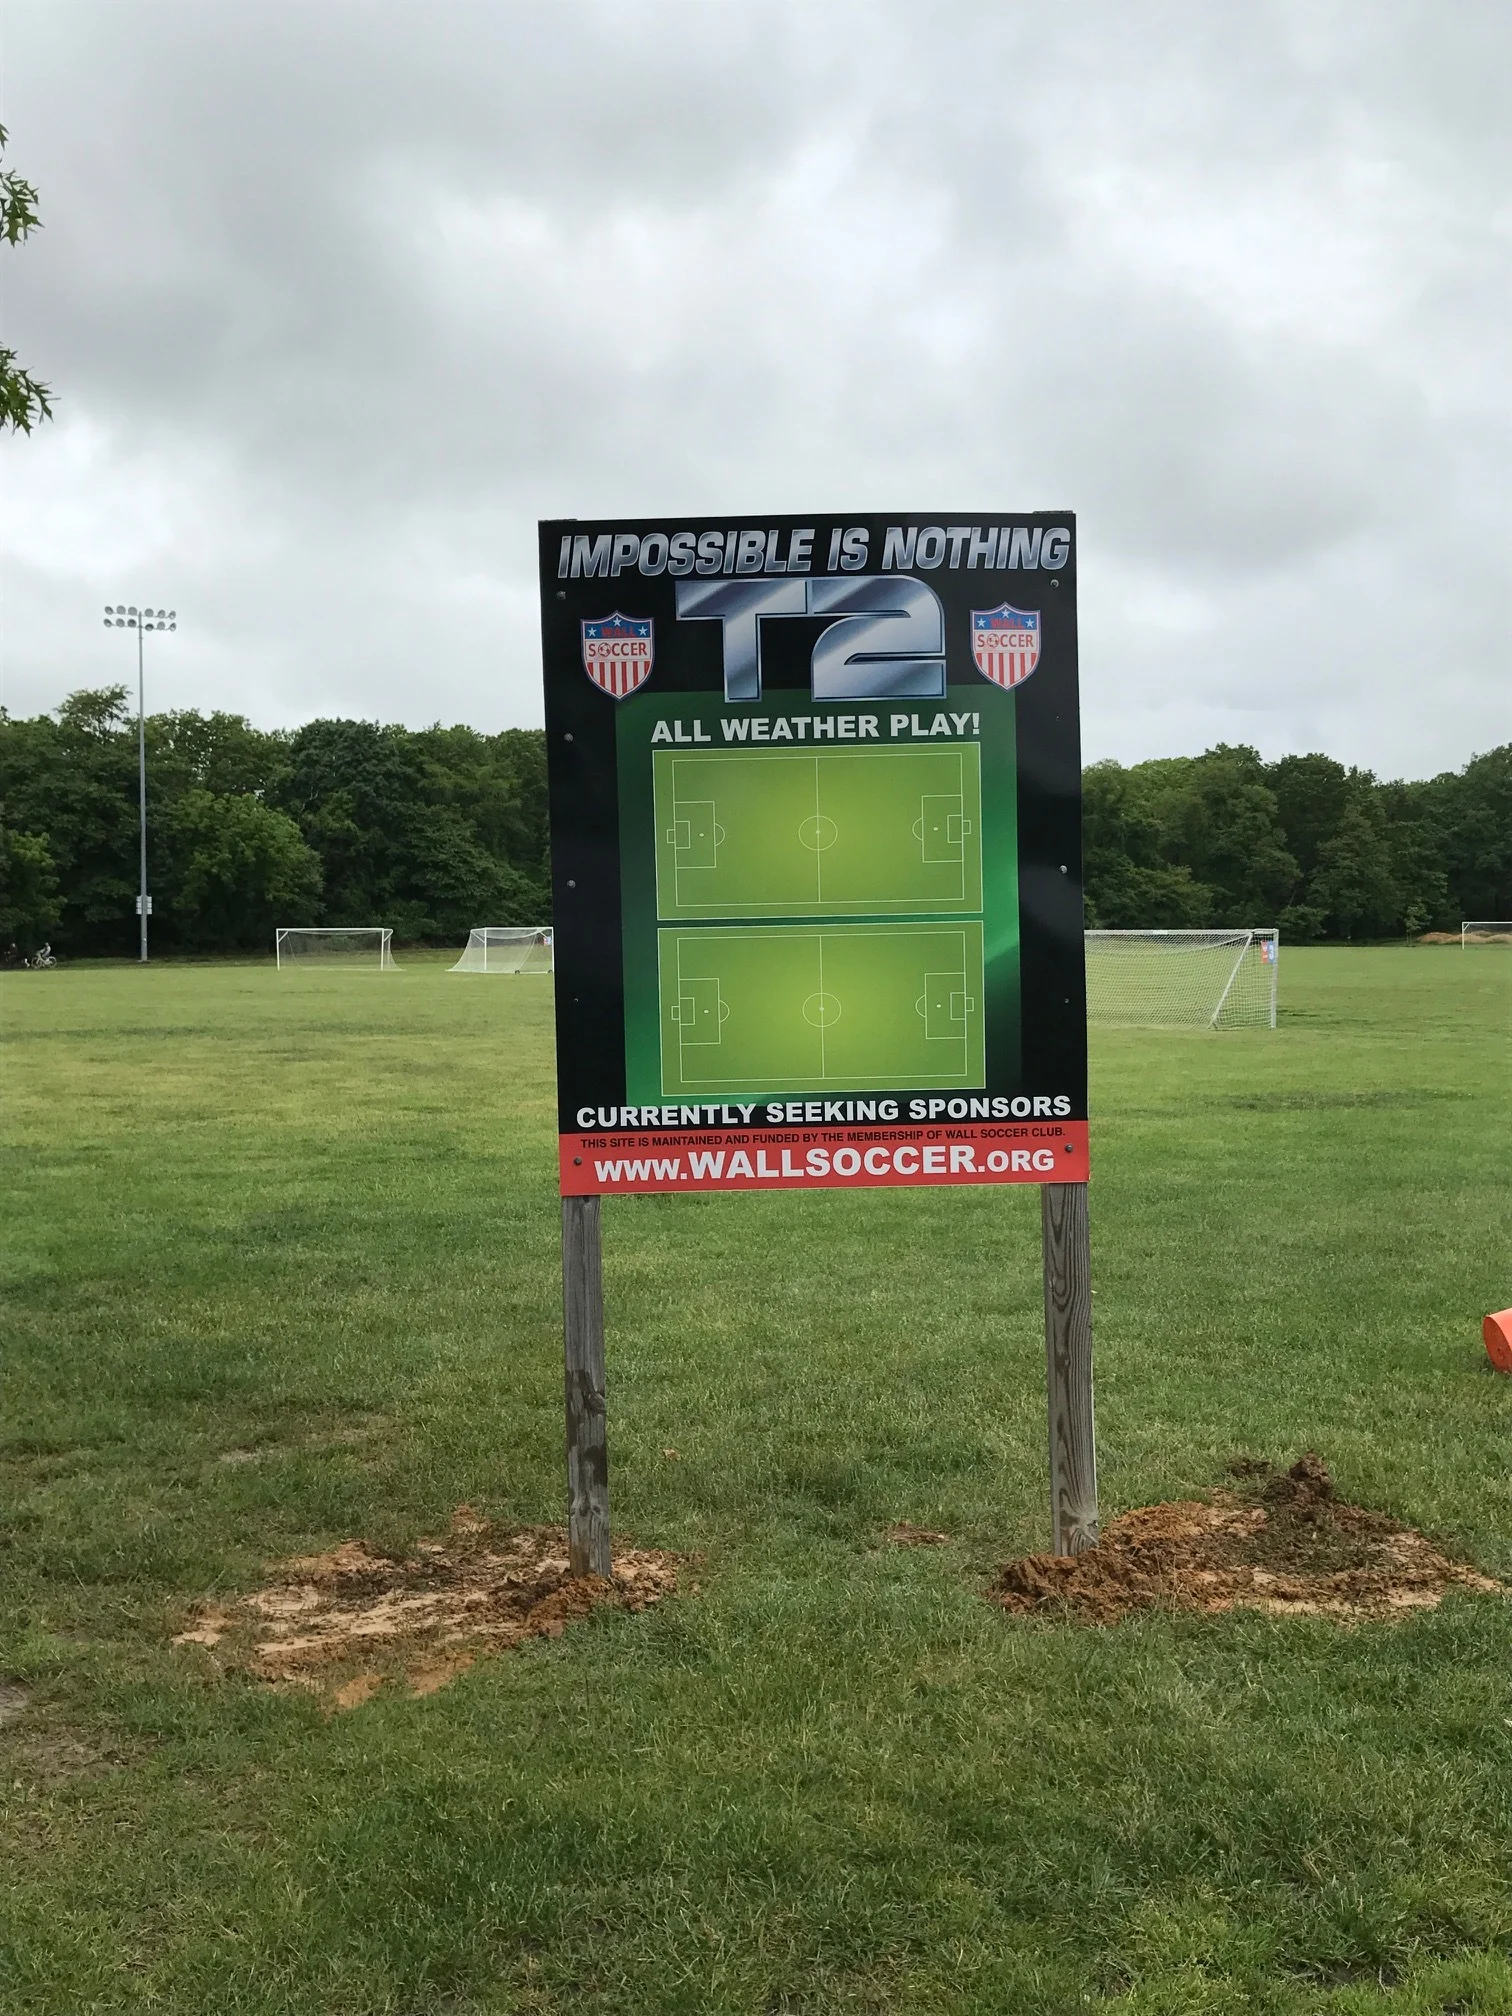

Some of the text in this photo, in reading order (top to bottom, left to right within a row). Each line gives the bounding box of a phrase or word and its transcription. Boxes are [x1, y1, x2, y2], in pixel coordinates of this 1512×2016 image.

[557, 526, 1071, 579] IMPOSSIBLE IS NOTHING
[601, 626, 636, 637] WALL
[990, 617, 1025, 629] WALL
[675, 574, 947, 703] T2
[977, 633, 1034, 648] SOCCER
[588, 642, 648, 657] SOCCER
[651, 713, 980, 743] ALL WEATHER PLAY!
[576, 1095, 1071, 1128] CURRENTLY SEEKING SPONSORS
[581, 1127, 1066, 1148] THIS SITE IS MAINTAINED AND FUNDED BY THE MEMBERSHIP OF WALL SOCCER CLUB.
